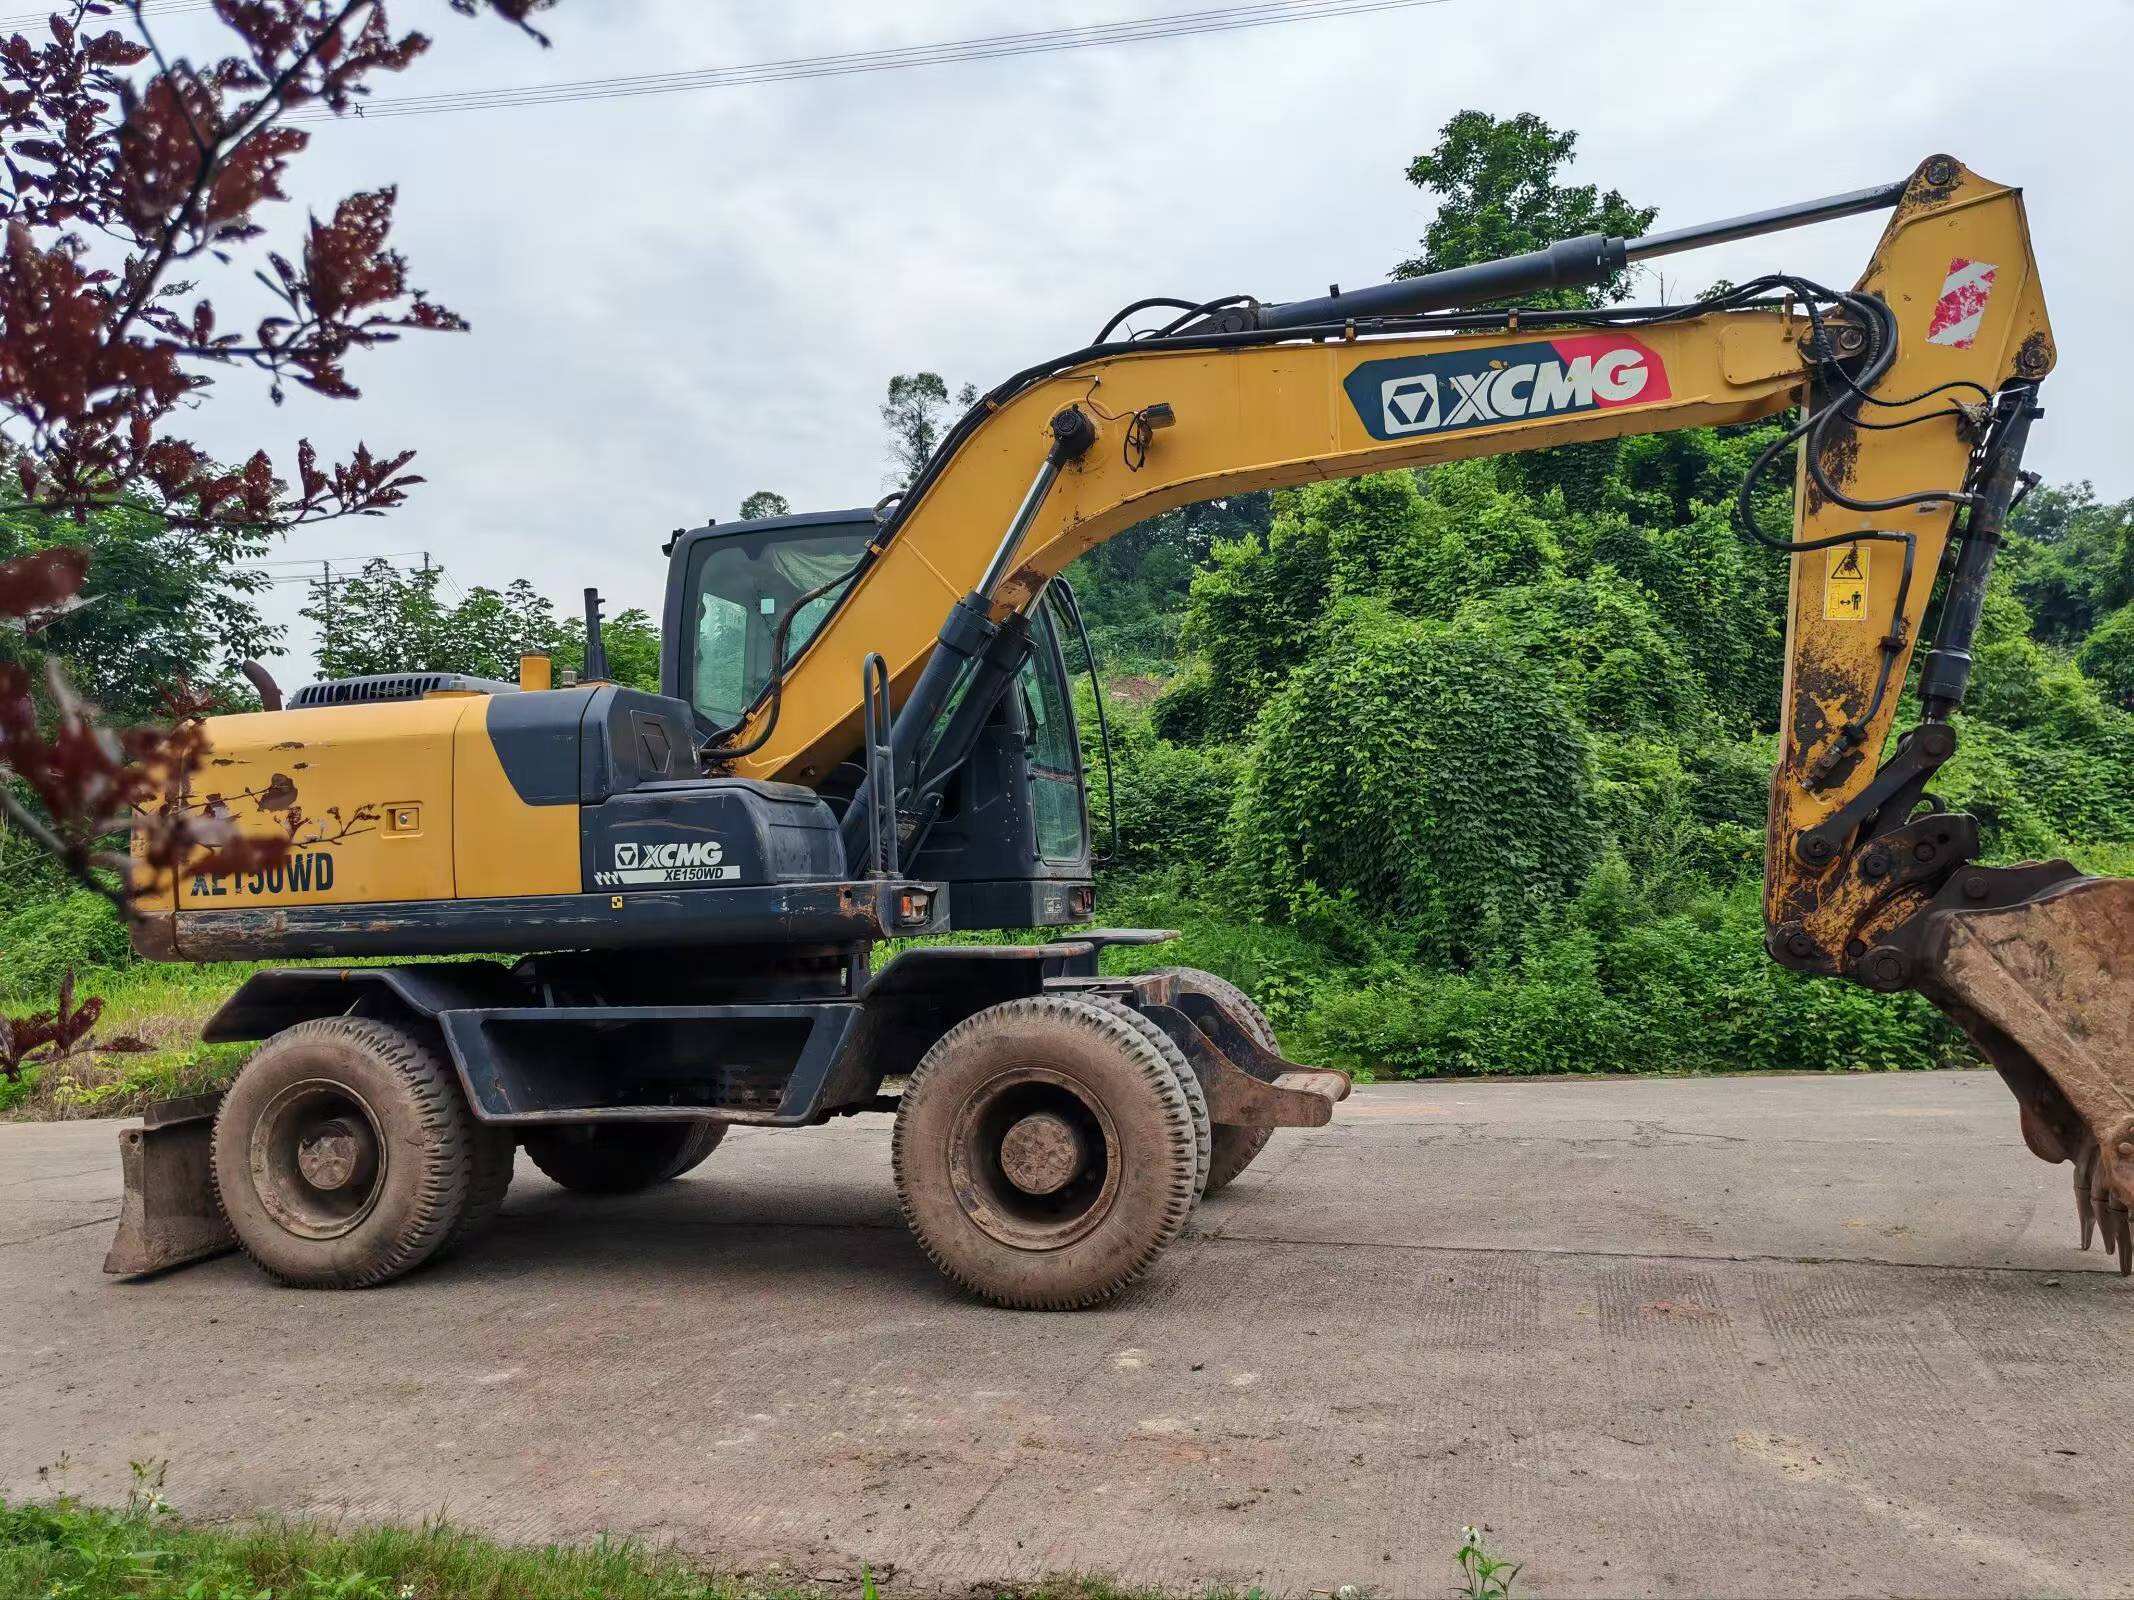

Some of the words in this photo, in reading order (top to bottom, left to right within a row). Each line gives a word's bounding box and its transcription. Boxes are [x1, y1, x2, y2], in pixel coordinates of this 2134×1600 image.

[1440, 349, 1649, 427] XCMG
[639, 841, 723, 869] XCMG
[664, 867, 724, 882] XE150WD
